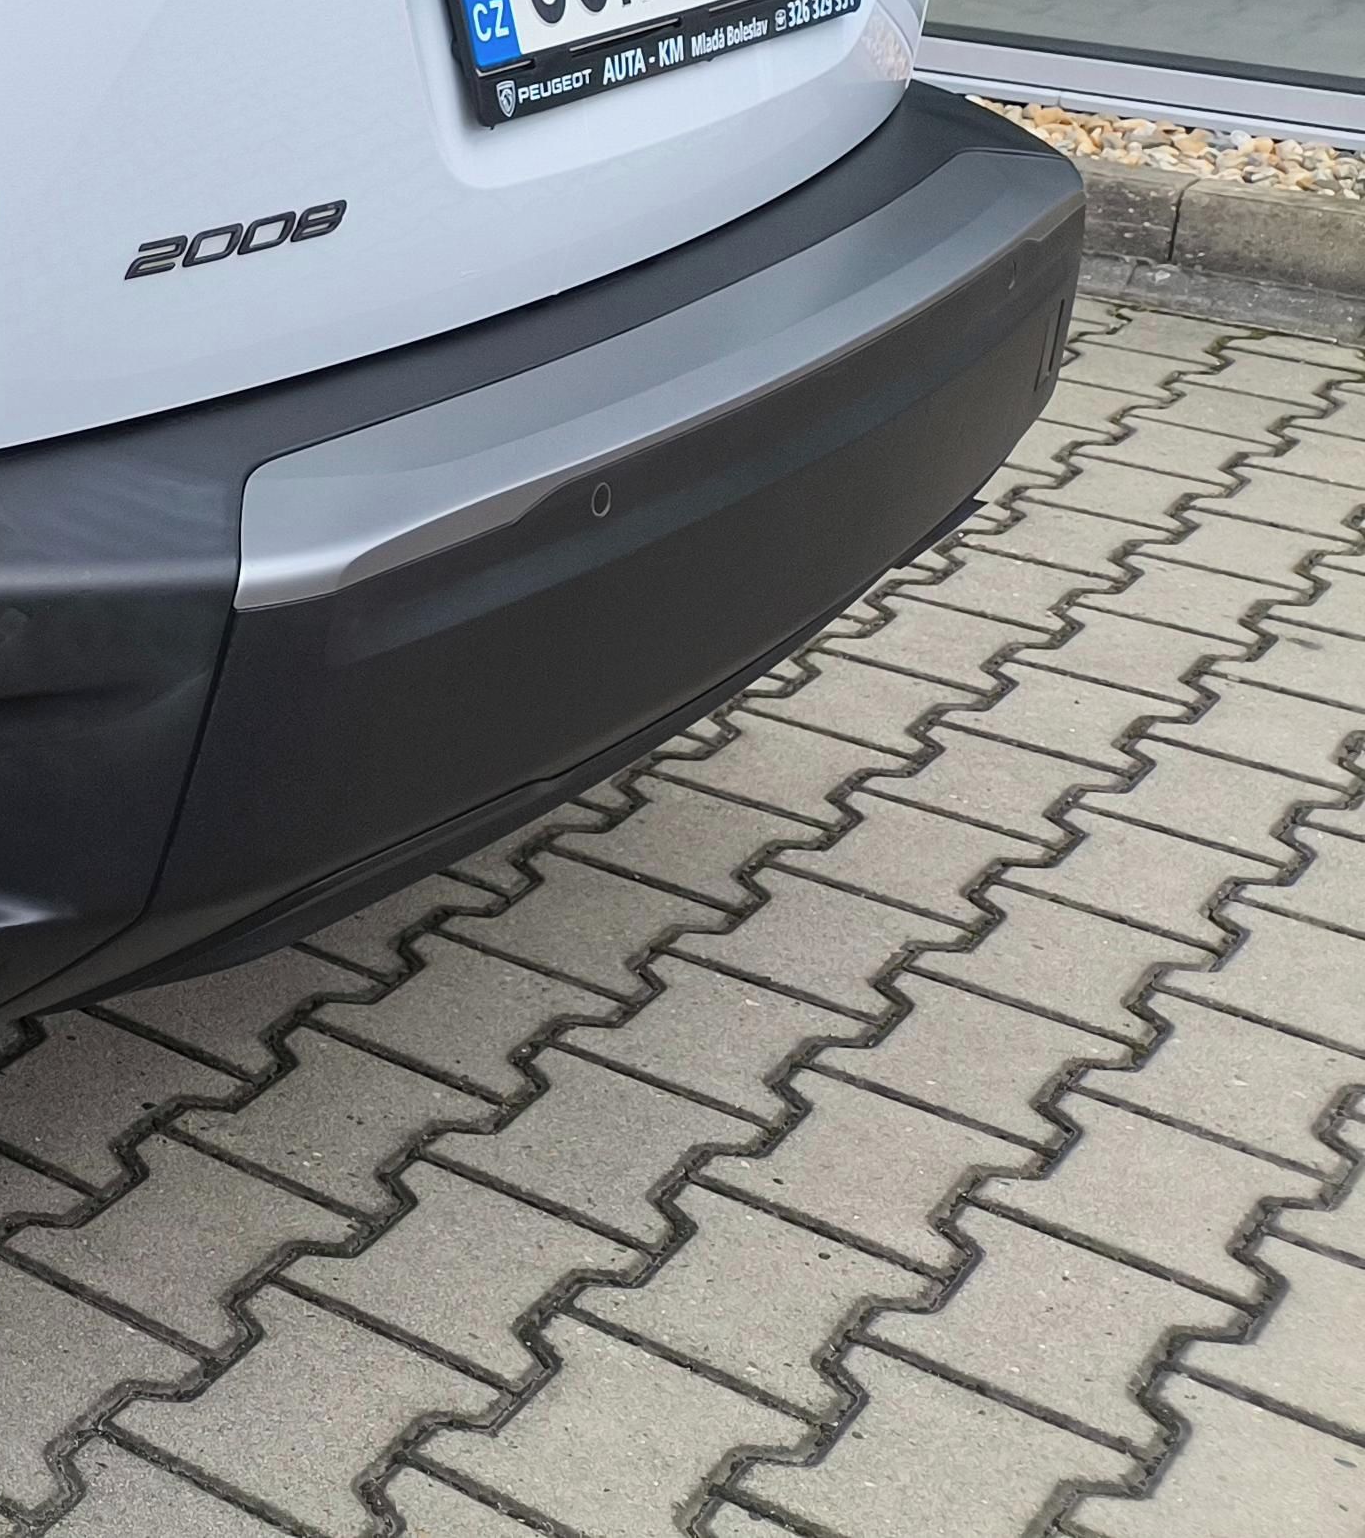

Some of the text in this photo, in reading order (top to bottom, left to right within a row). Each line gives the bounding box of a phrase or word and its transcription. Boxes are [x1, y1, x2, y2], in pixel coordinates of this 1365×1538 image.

[518, 68, 593, 104] PEUGEOT
[602, 48, 646, 85] AUTA
[658, 35, 685, 68] KM
[691, 28, 726, 57] Mladá
[726, 17, 769, 47] Boleslav
[124, 199, 347, 280] 2008
